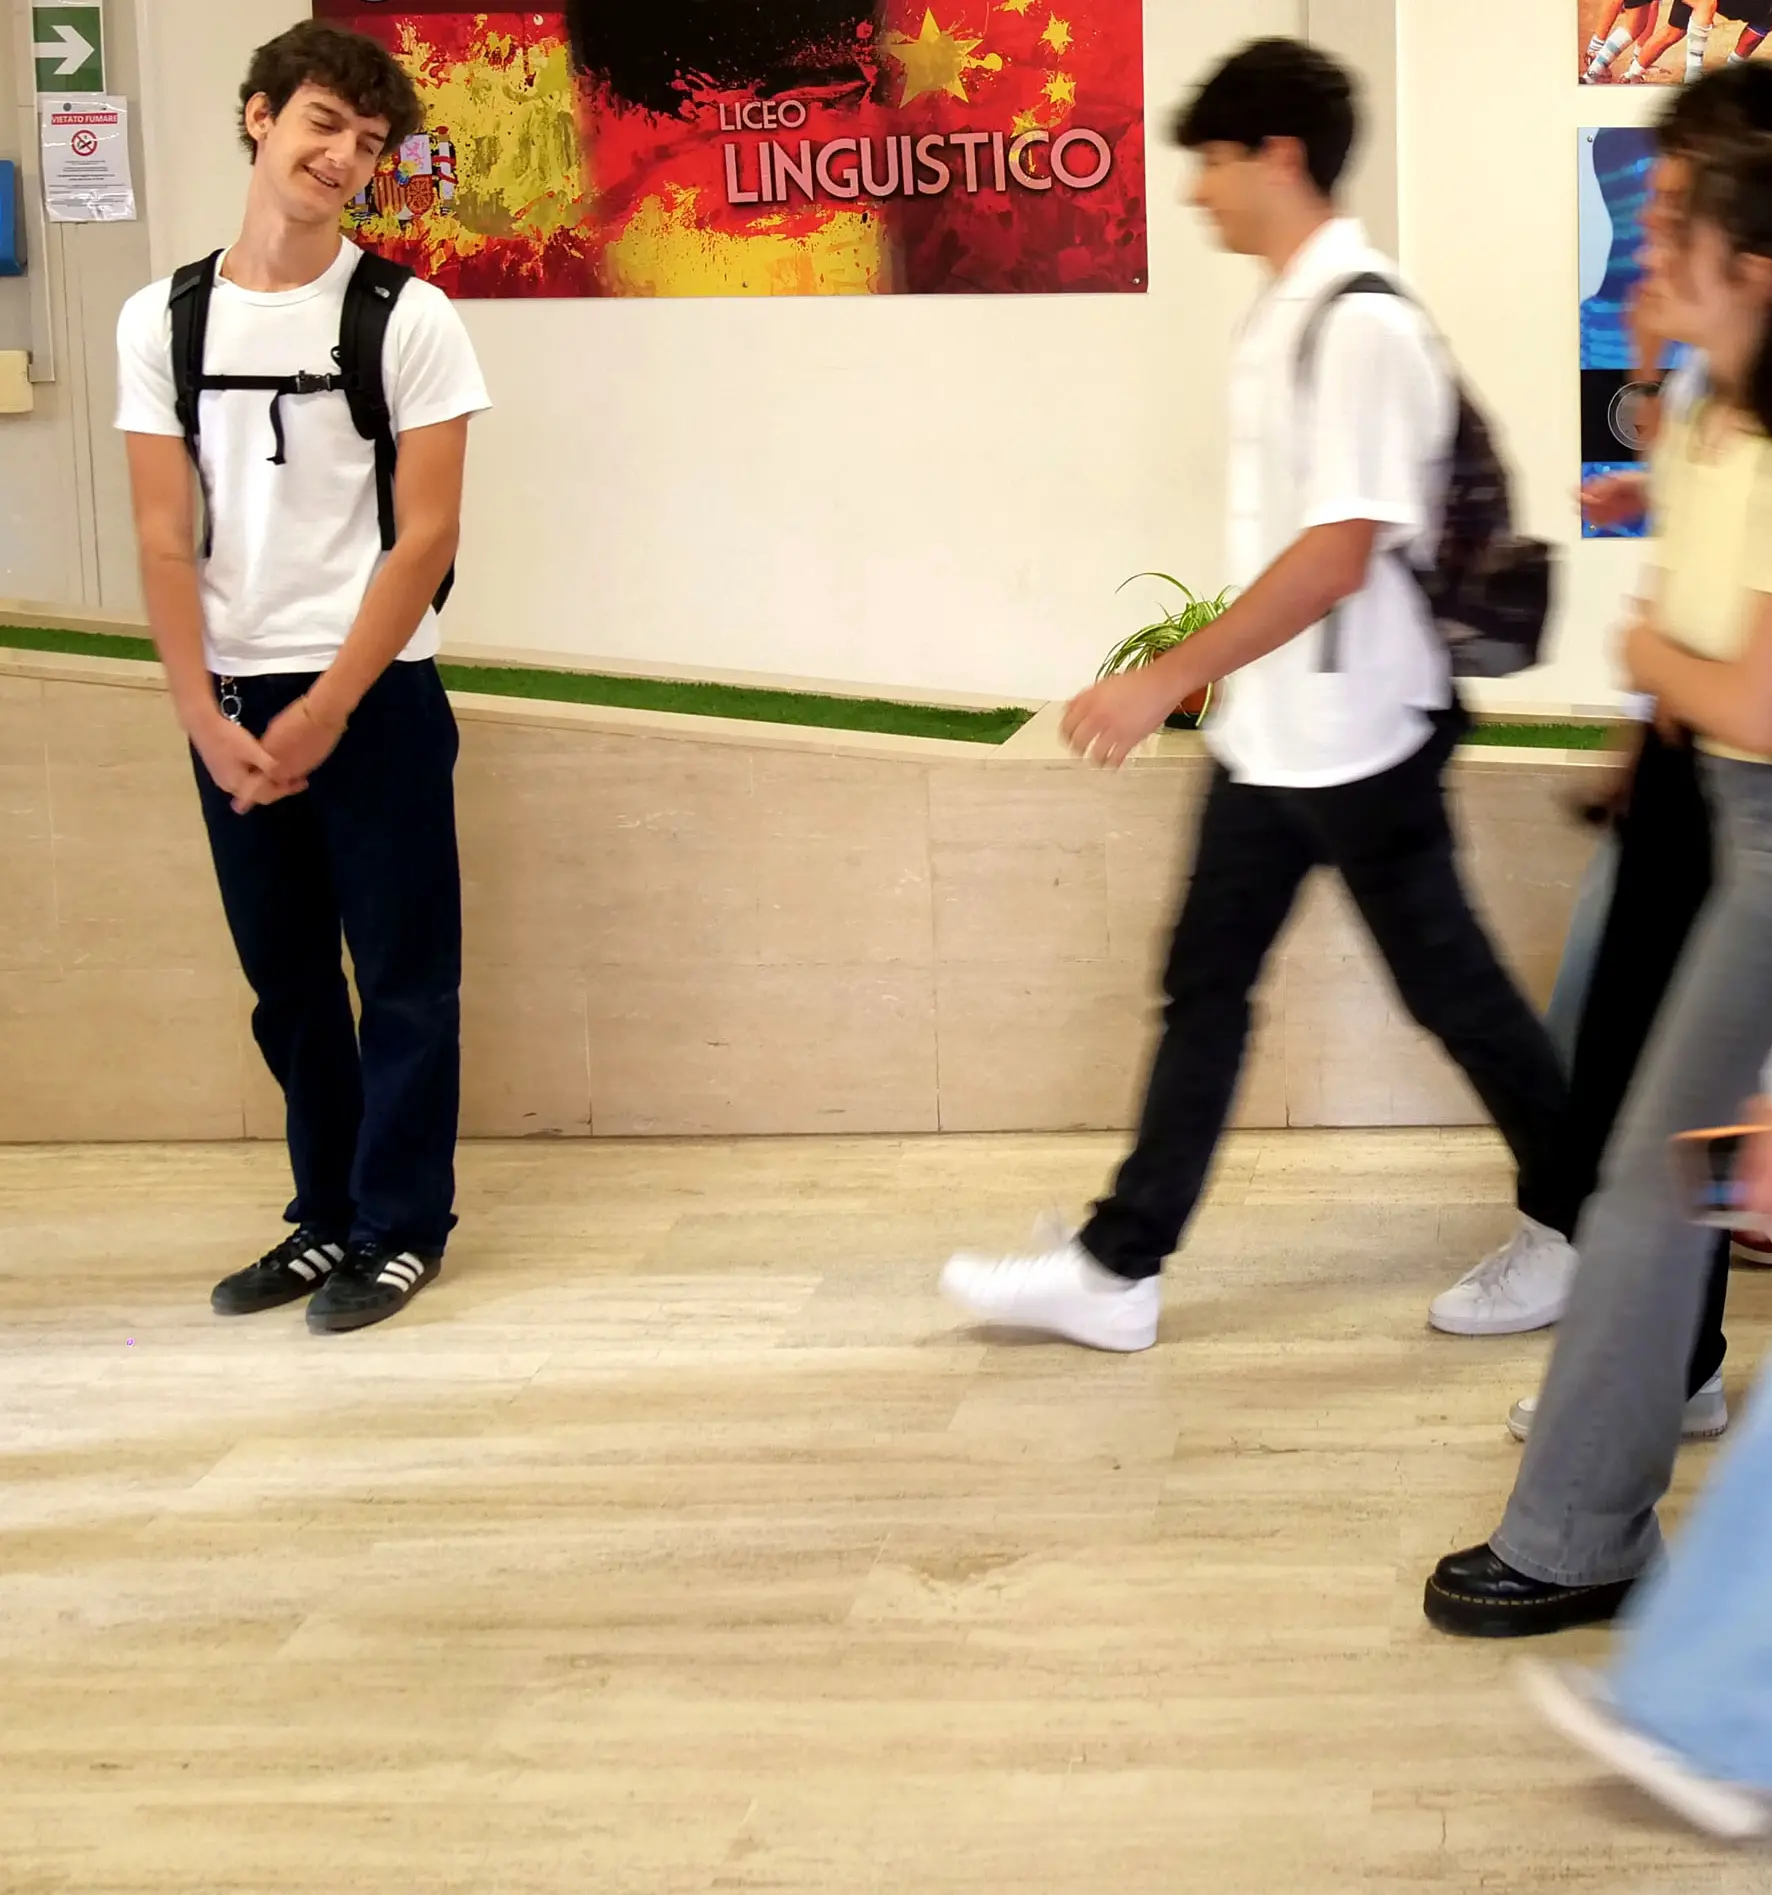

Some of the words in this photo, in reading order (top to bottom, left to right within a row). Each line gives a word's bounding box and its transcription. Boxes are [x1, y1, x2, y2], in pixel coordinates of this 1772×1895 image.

[52, 115, 84, 123] VIETATO
[85, 114, 118, 122] FUMARE
[719, 99, 806, 131] LICEO
[724, 128, 1111, 203] LINGUISTICO
